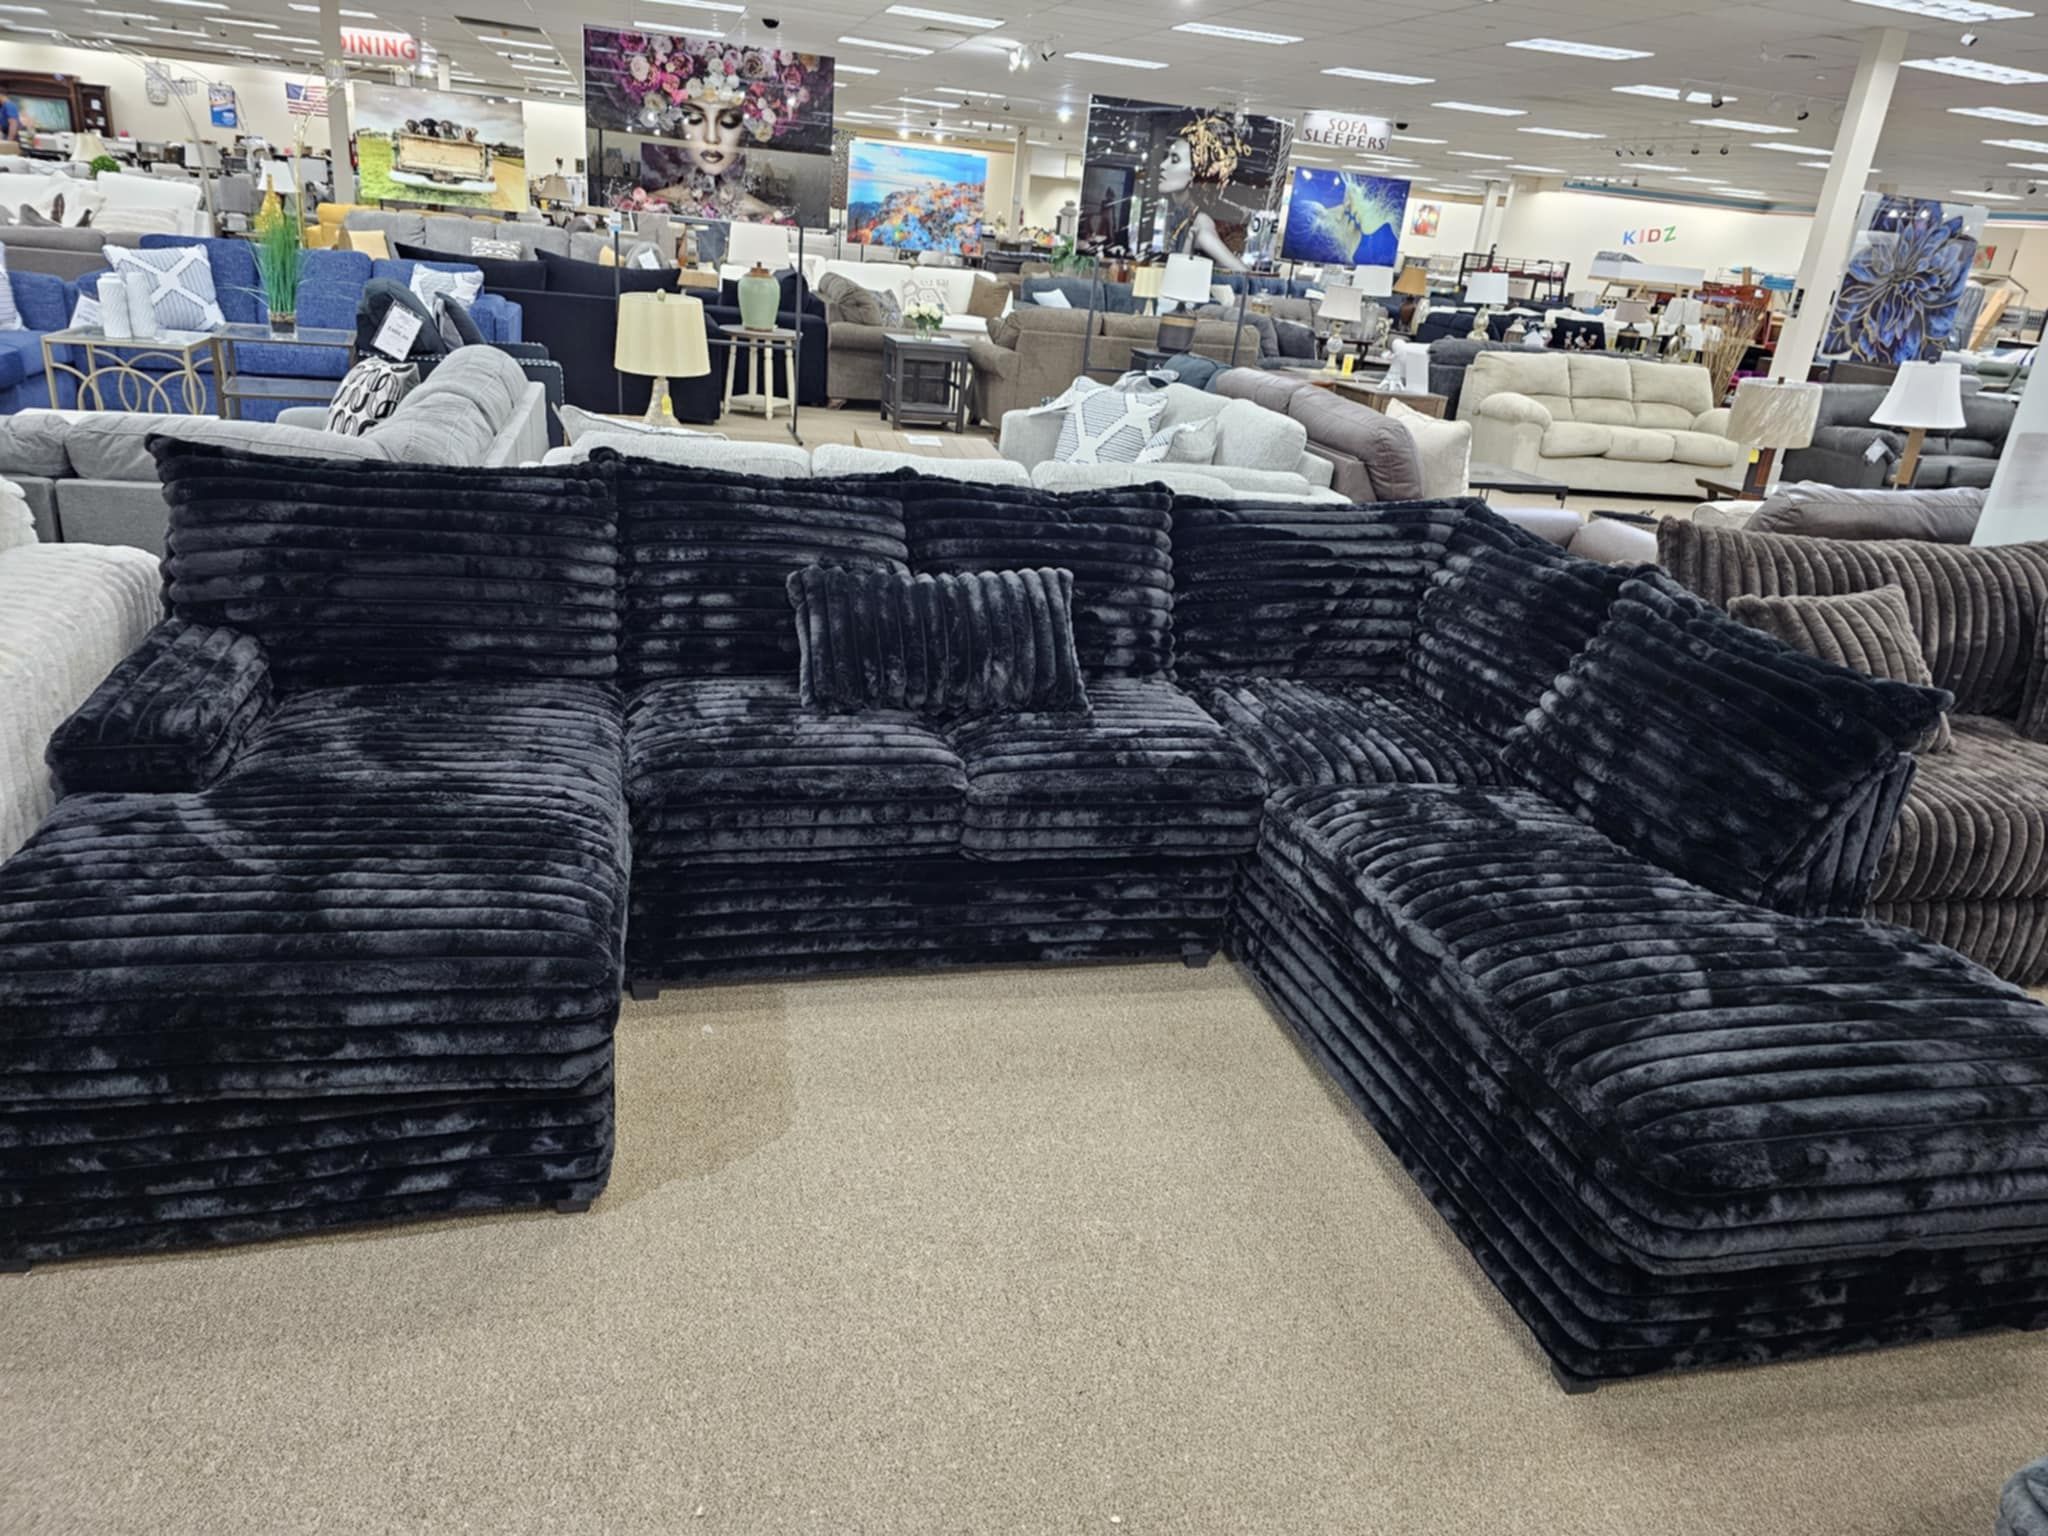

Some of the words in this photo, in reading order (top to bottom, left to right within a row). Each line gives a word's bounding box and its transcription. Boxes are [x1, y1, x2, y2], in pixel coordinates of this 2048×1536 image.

[1328, 118, 1369, 135] SOFA
[1303, 128, 1387, 151] SLEEPERS
[1623, 225, 1677, 246] KIDZ
